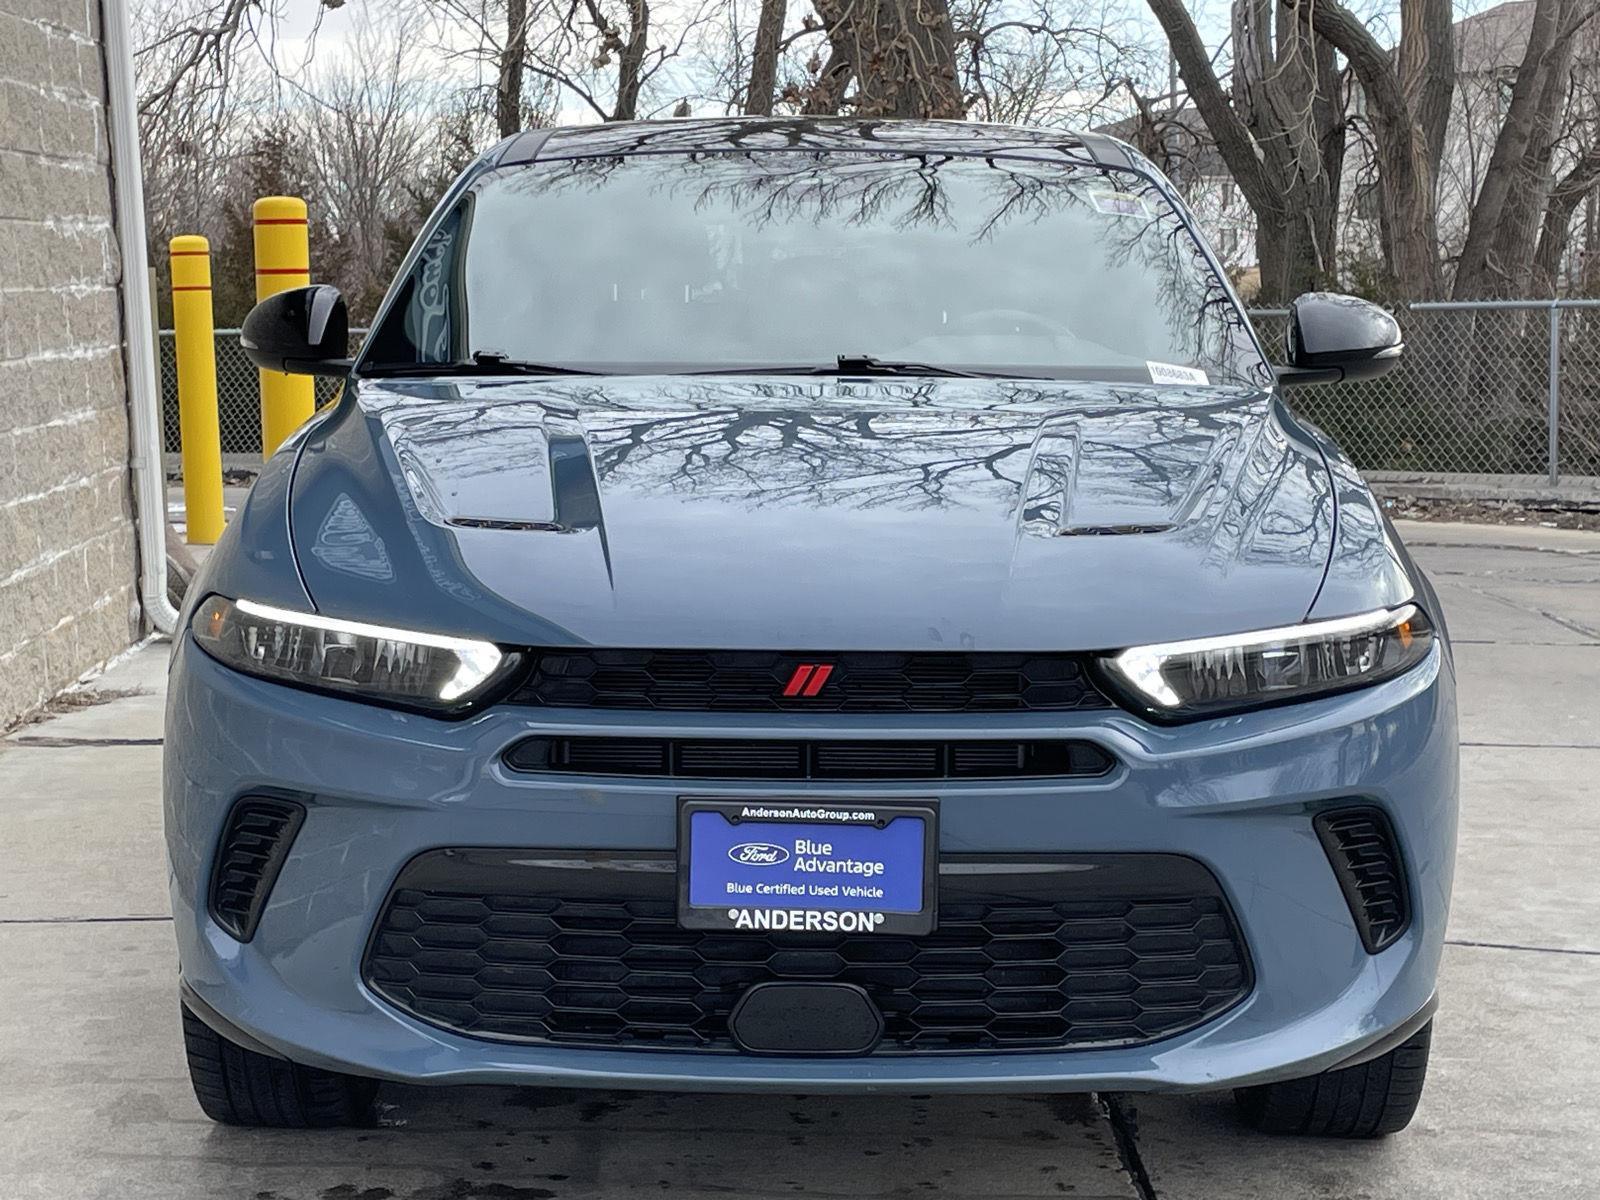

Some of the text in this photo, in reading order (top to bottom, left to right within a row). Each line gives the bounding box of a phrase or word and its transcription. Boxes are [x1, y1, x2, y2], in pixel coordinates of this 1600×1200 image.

[742, 807, 874, 821] AndersonAutoGroup.com
[739, 846, 778, 862] Ford
[796, 840, 832, 855] Blue
[794, 857, 884, 876] Advantage
[727, 883, 883, 897] Blue Certified Used Vehicle
[735, 909, 875, 931] ANDERSON
